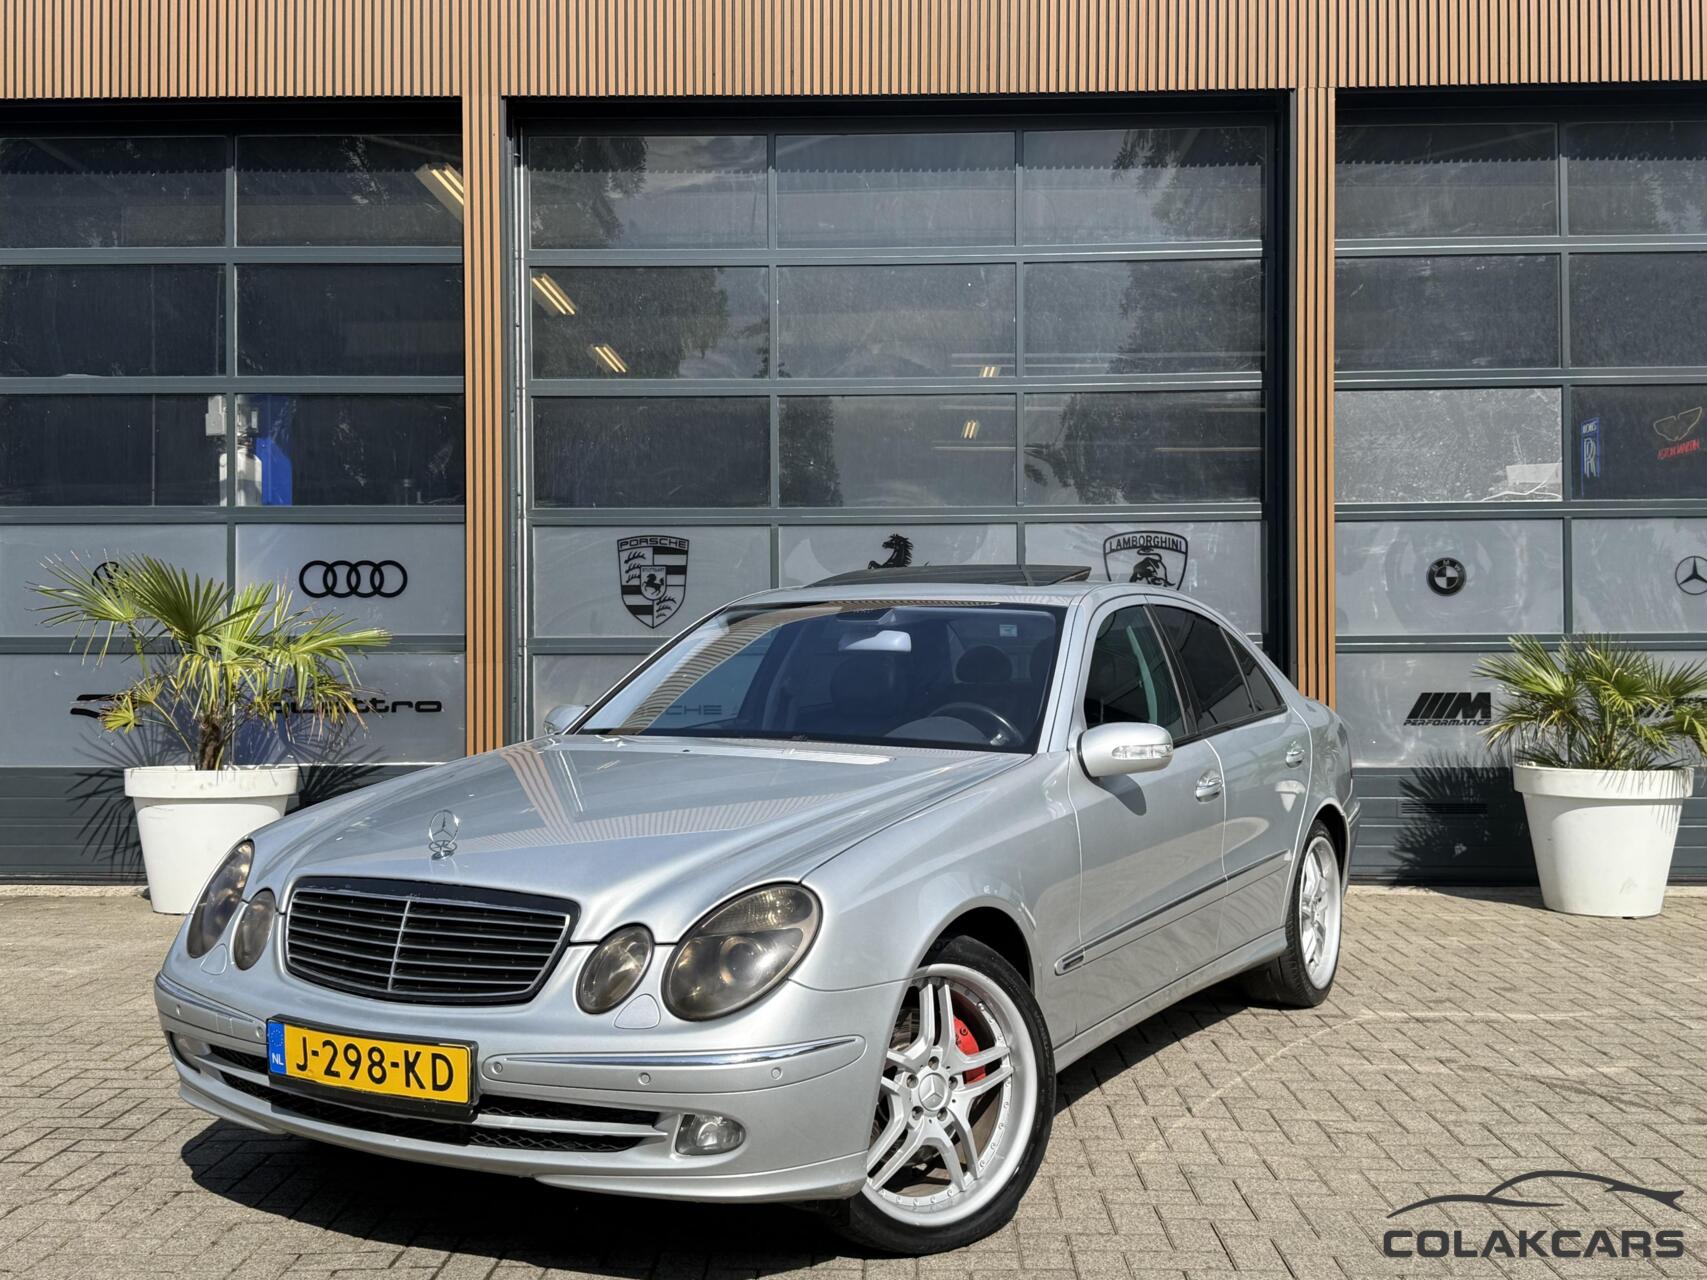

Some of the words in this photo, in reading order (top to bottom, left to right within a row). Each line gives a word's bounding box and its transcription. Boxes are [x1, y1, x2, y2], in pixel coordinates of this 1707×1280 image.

[619, 537, 687, 549] PORSCHE
[1109, 535, 1183, 553] LAMBORGHINI
[1403, 719, 1491, 727] PERFORMANCE
[271, 1052, 284, 1066] NL
[296, 1036, 455, 1092] J-298-KD
